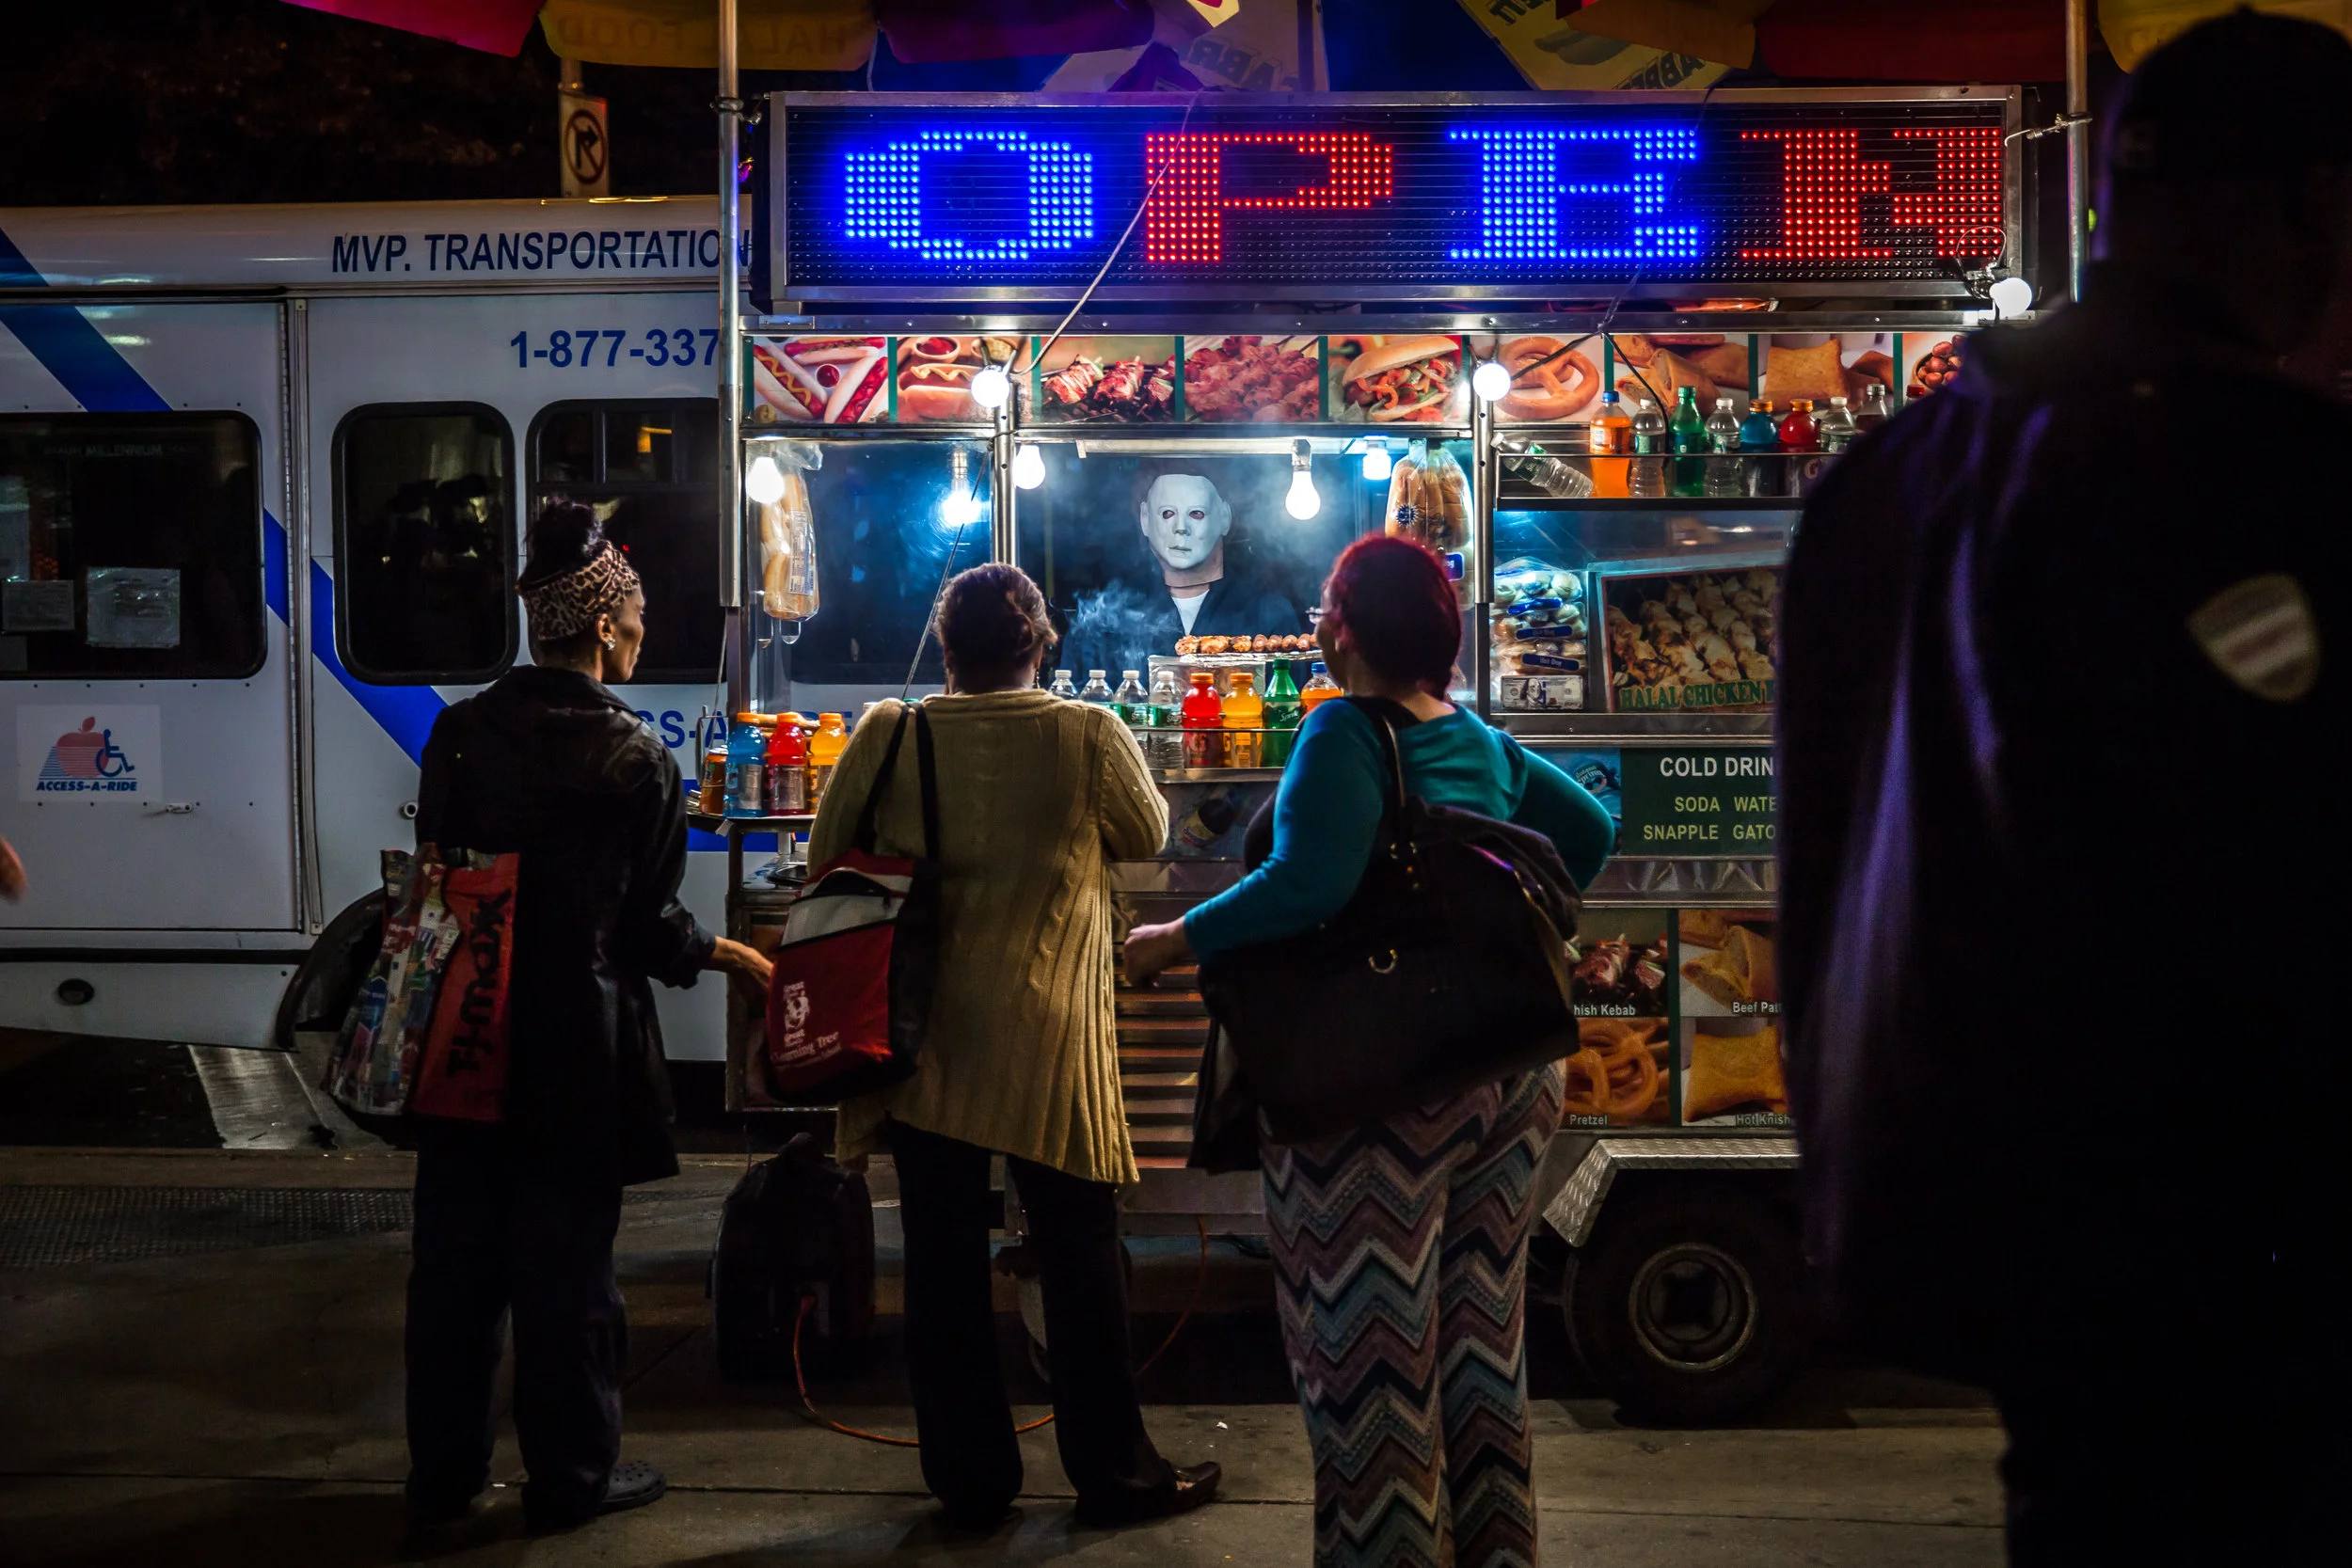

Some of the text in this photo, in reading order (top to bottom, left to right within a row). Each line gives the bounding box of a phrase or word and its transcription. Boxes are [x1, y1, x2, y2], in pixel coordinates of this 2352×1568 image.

[842, 128, 2003, 265] OPEN
[332, 229, 750, 273] MVP. TRANSPORTATION
[1620, 686, 1680, 709] HALAL
[1683, 679, 1762, 706] CHICKEN
[1660, 756, 1774, 778] COLD DRIN
[36, 781, 137, 791] ACCESS-A-RIDE
[1674, 796, 1777, 813] SODA WATE
[1643, 824, 1777, 841] SNAPPLE GATO
[1573, 1004, 1636, 1016] hish Kebab
[1732, 1001, 1783, 1013] Beef Patt
[1569, 1114, 1608, 1125] Pretzel
[1736, 1114, 1756, 1126] Hot
